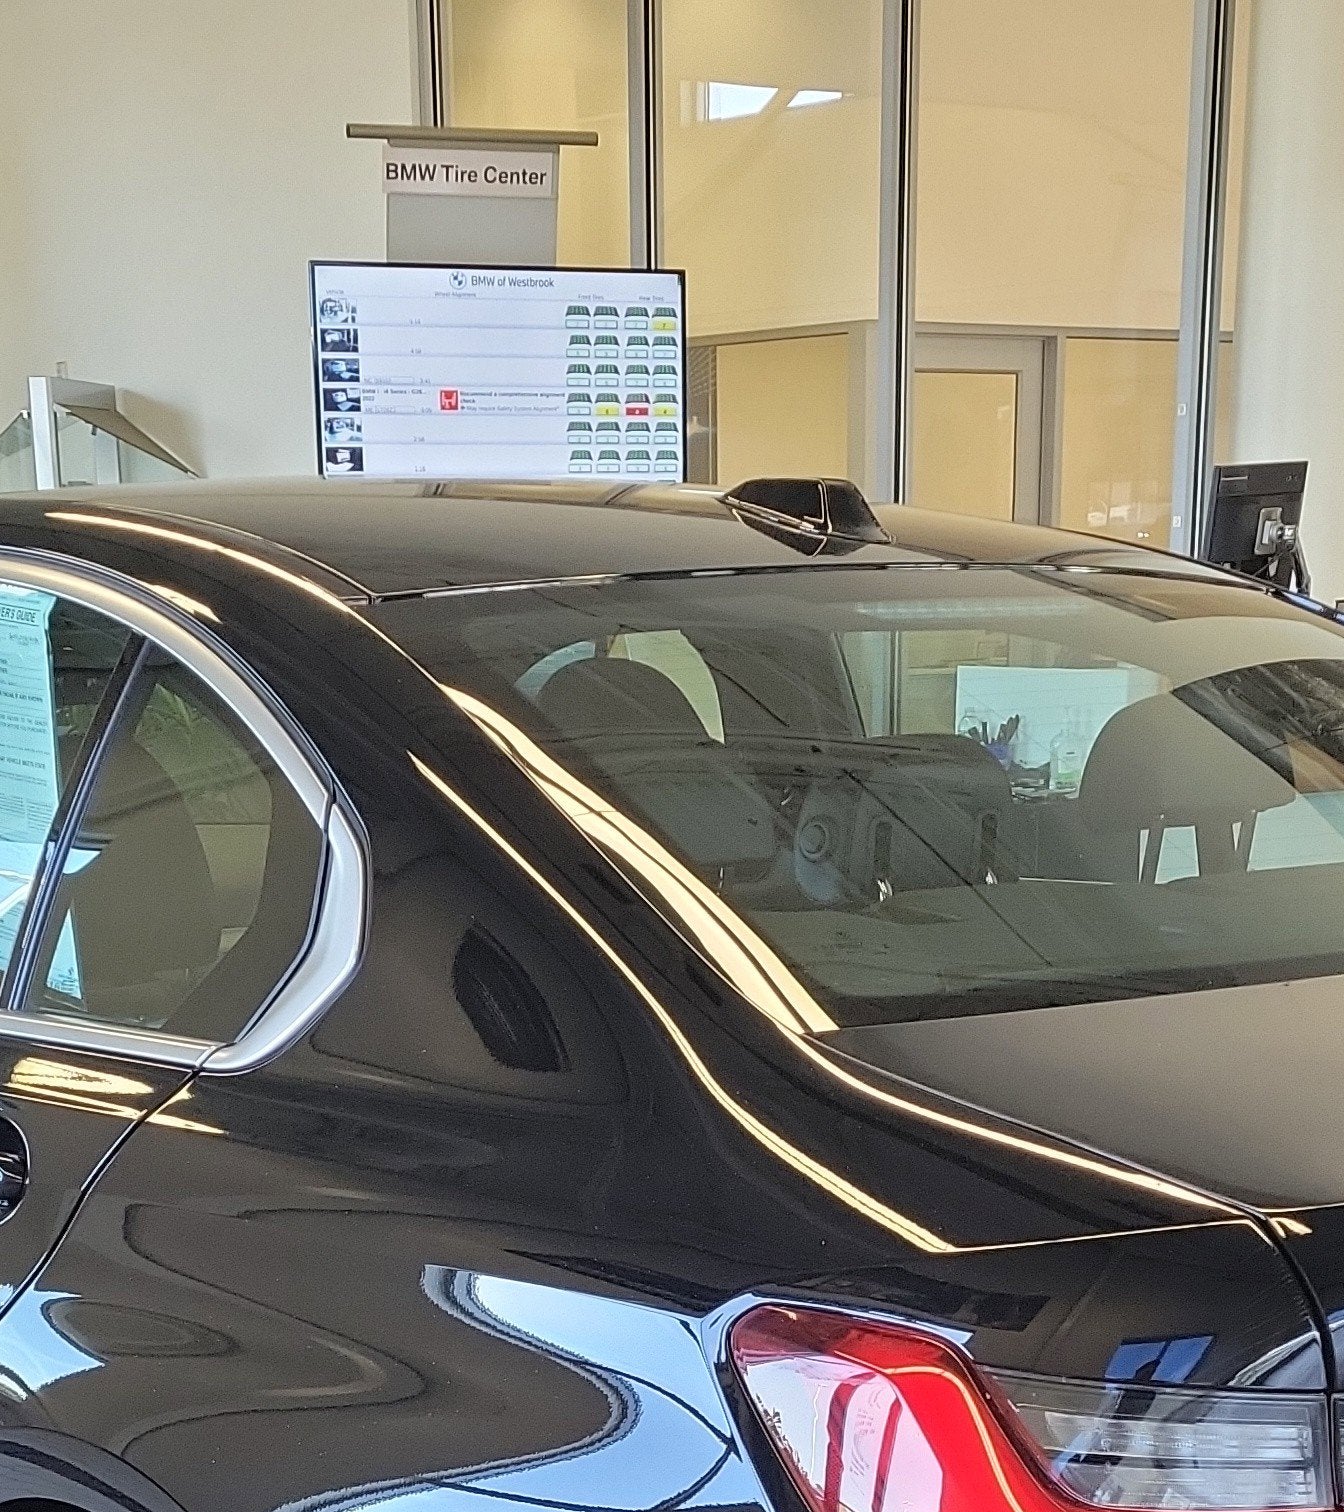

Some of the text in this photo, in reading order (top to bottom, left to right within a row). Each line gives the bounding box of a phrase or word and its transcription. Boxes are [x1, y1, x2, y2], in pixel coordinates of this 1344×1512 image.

[385, 162, 547, 186] BMW Tire Center
[471, 275, 555, 288] BMW of Westbrook
[16, 609, 37, 623] GUIDE
